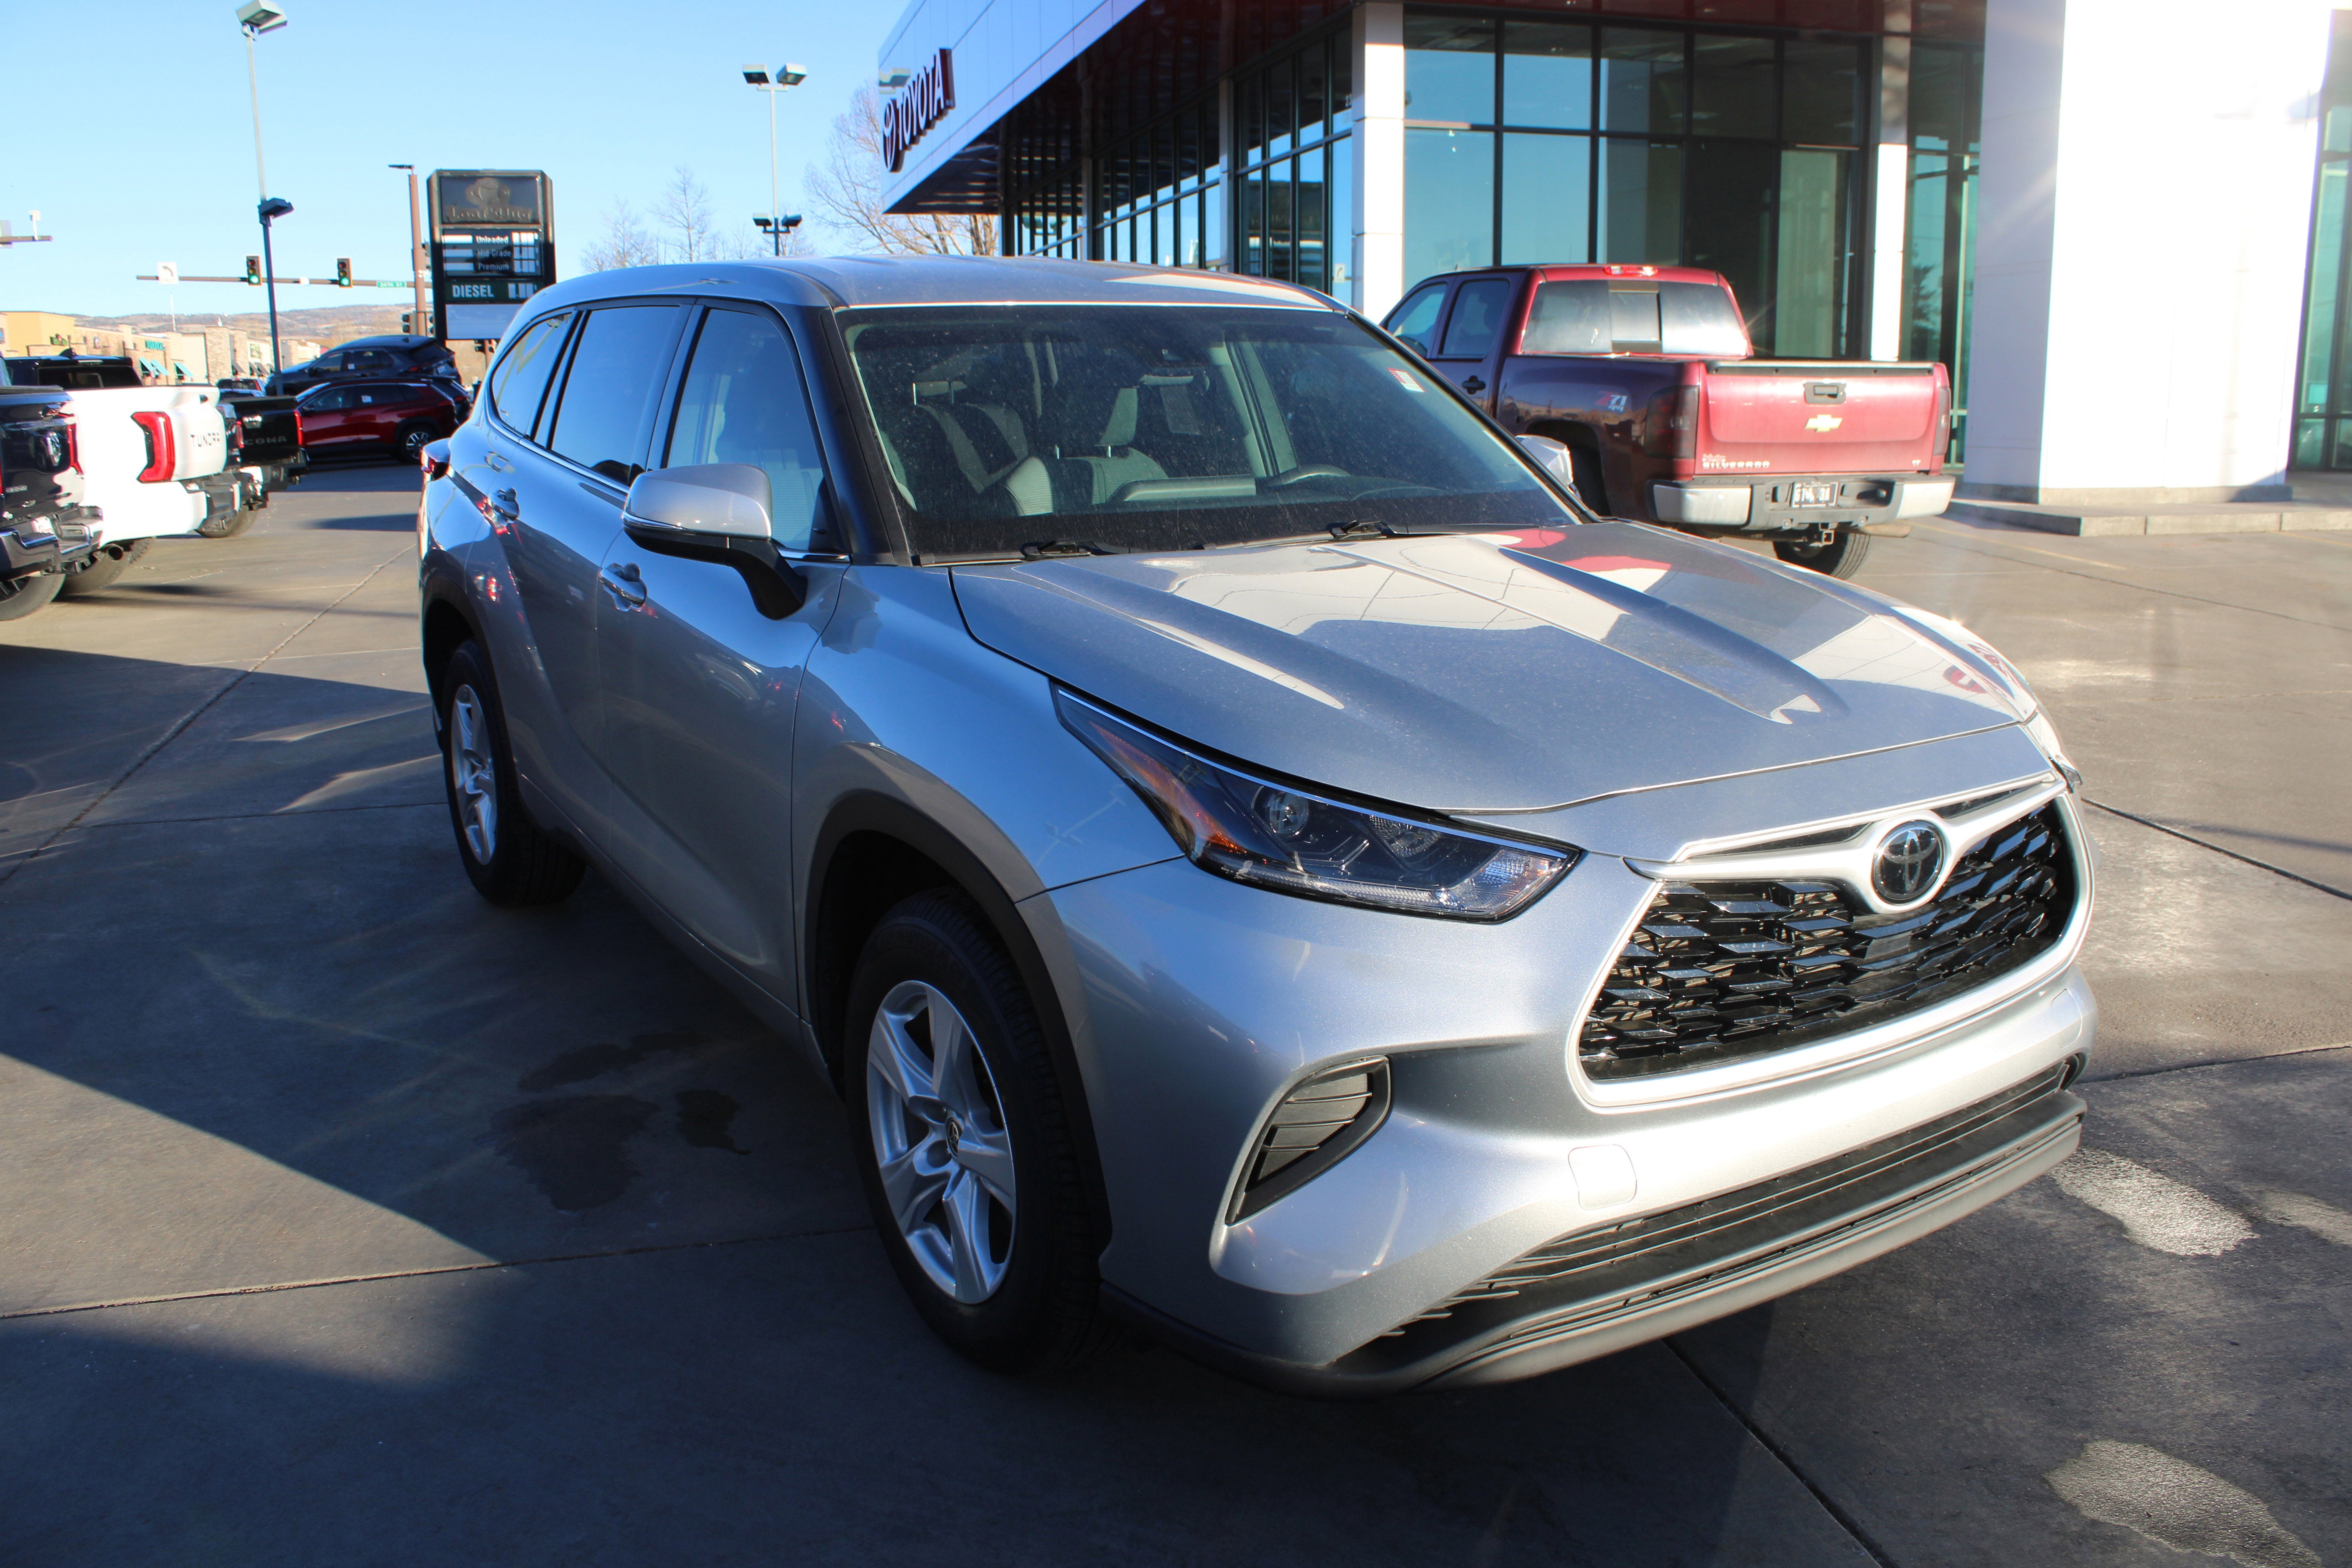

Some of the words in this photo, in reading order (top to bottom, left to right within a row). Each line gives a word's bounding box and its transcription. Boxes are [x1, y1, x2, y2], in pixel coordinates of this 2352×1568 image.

[896, 48, 954, 150] TOYOTA
[475, 235, 509, 244] Unleaded
[452, 285, 494, 298] DIESEL
[1596, 391, 1627, 406] Z71
[190, 432, 220, 448] TUNDRA
[244, 436, 287, 445] COMA
[1702, 461, 1770, 469] SILVERADO
